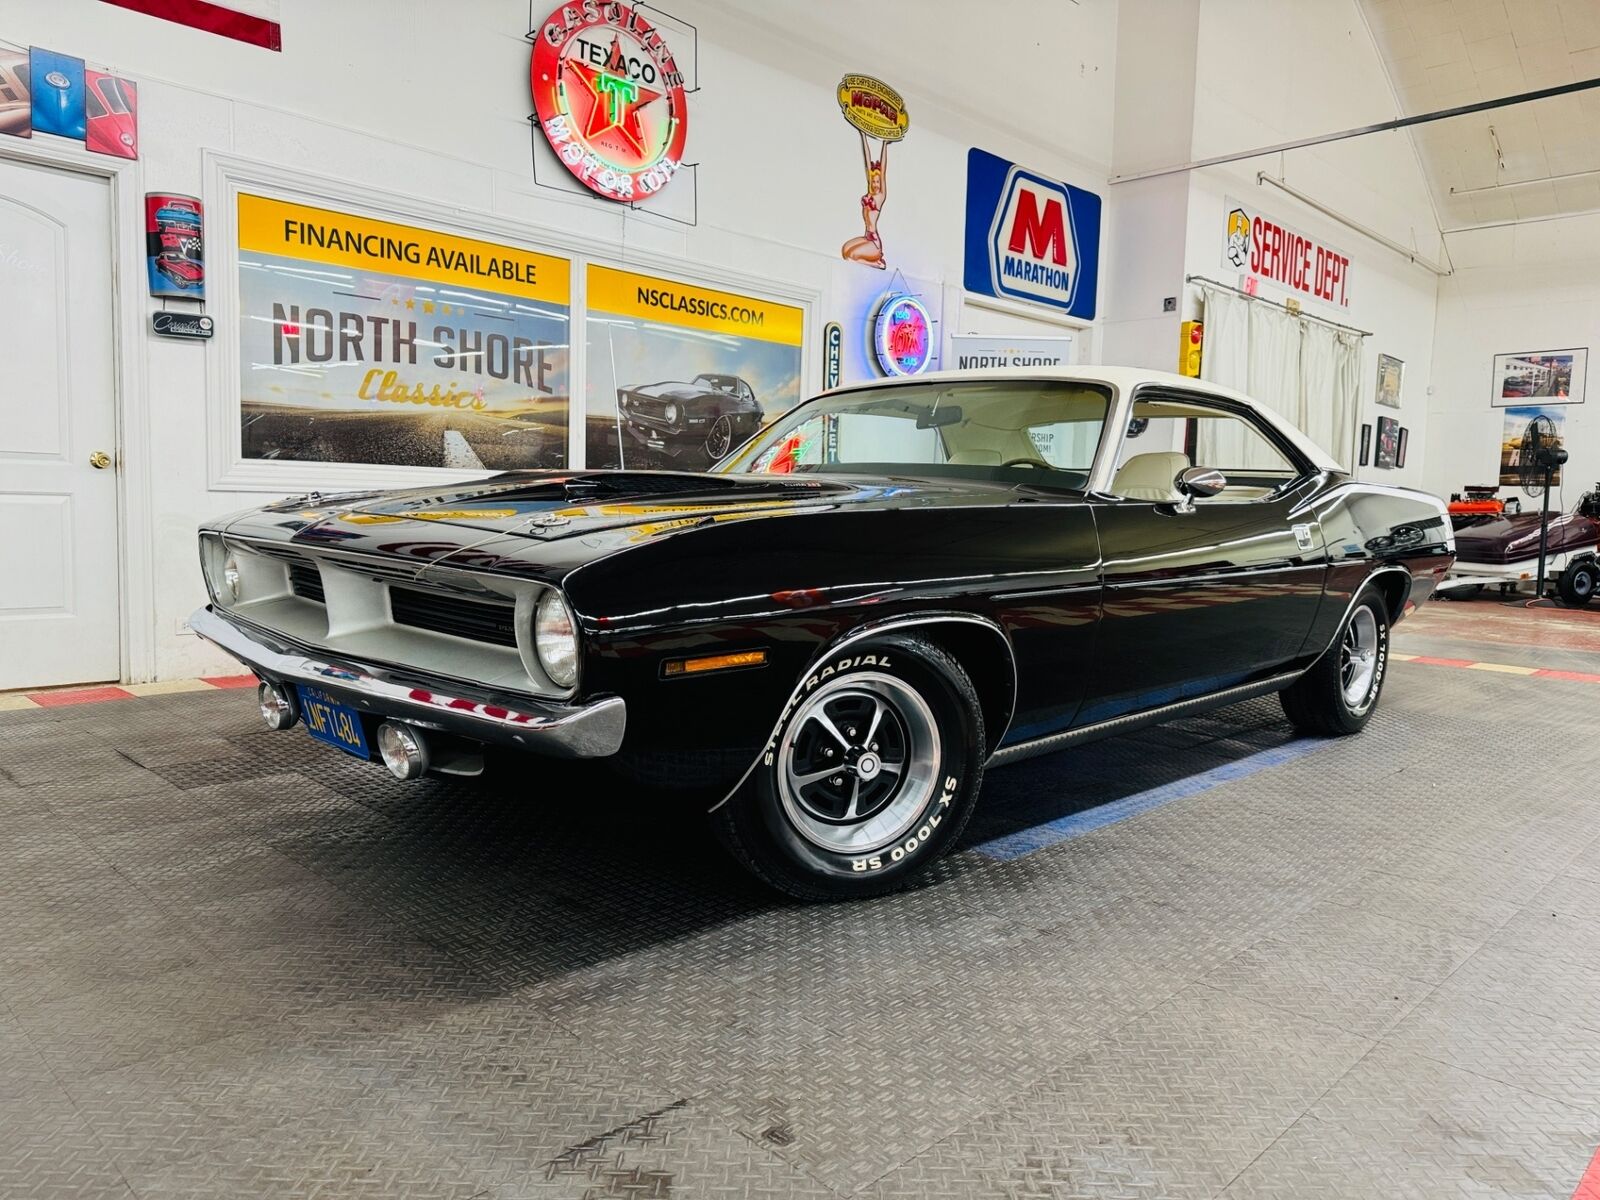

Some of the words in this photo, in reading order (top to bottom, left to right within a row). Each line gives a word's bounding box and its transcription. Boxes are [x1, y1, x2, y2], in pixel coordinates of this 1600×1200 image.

[576, 38, 656, 84] TEXACO
[850, 89, 898, 126] MOPAR
[544, 113, 635, 198] MOTOR
[1008, 188, 1068, 267] M
[284, 219, 421, 265] FINANCING
[425, 246, 537, 285] AVAILABLE
[1003, 255, 1070, 292] MARATHON
[1251, 216, 1313, 293] SERVICE
[1314, 246, 1349, 308] DEPT.
[637, 286, 765, 328] NSCLASSICS.COM
[272, 302, 417, 365] NORTH
[433, 325, 554, 394] SHORE
[958, 356, 1008, 370] NORTH
[358, 368, 488, 411] Classics
[829, 330, 840, 463] CHEVLET
[1380, 624, 1386, 639] SX
[806, 655, 892, 691] RADIAL
[303, 698, 361, 748] 1NFT484
[938, 775, 958, 808] SX
[890, 815, 943, 862] 7000
[852, 857, 883, 872] SR
